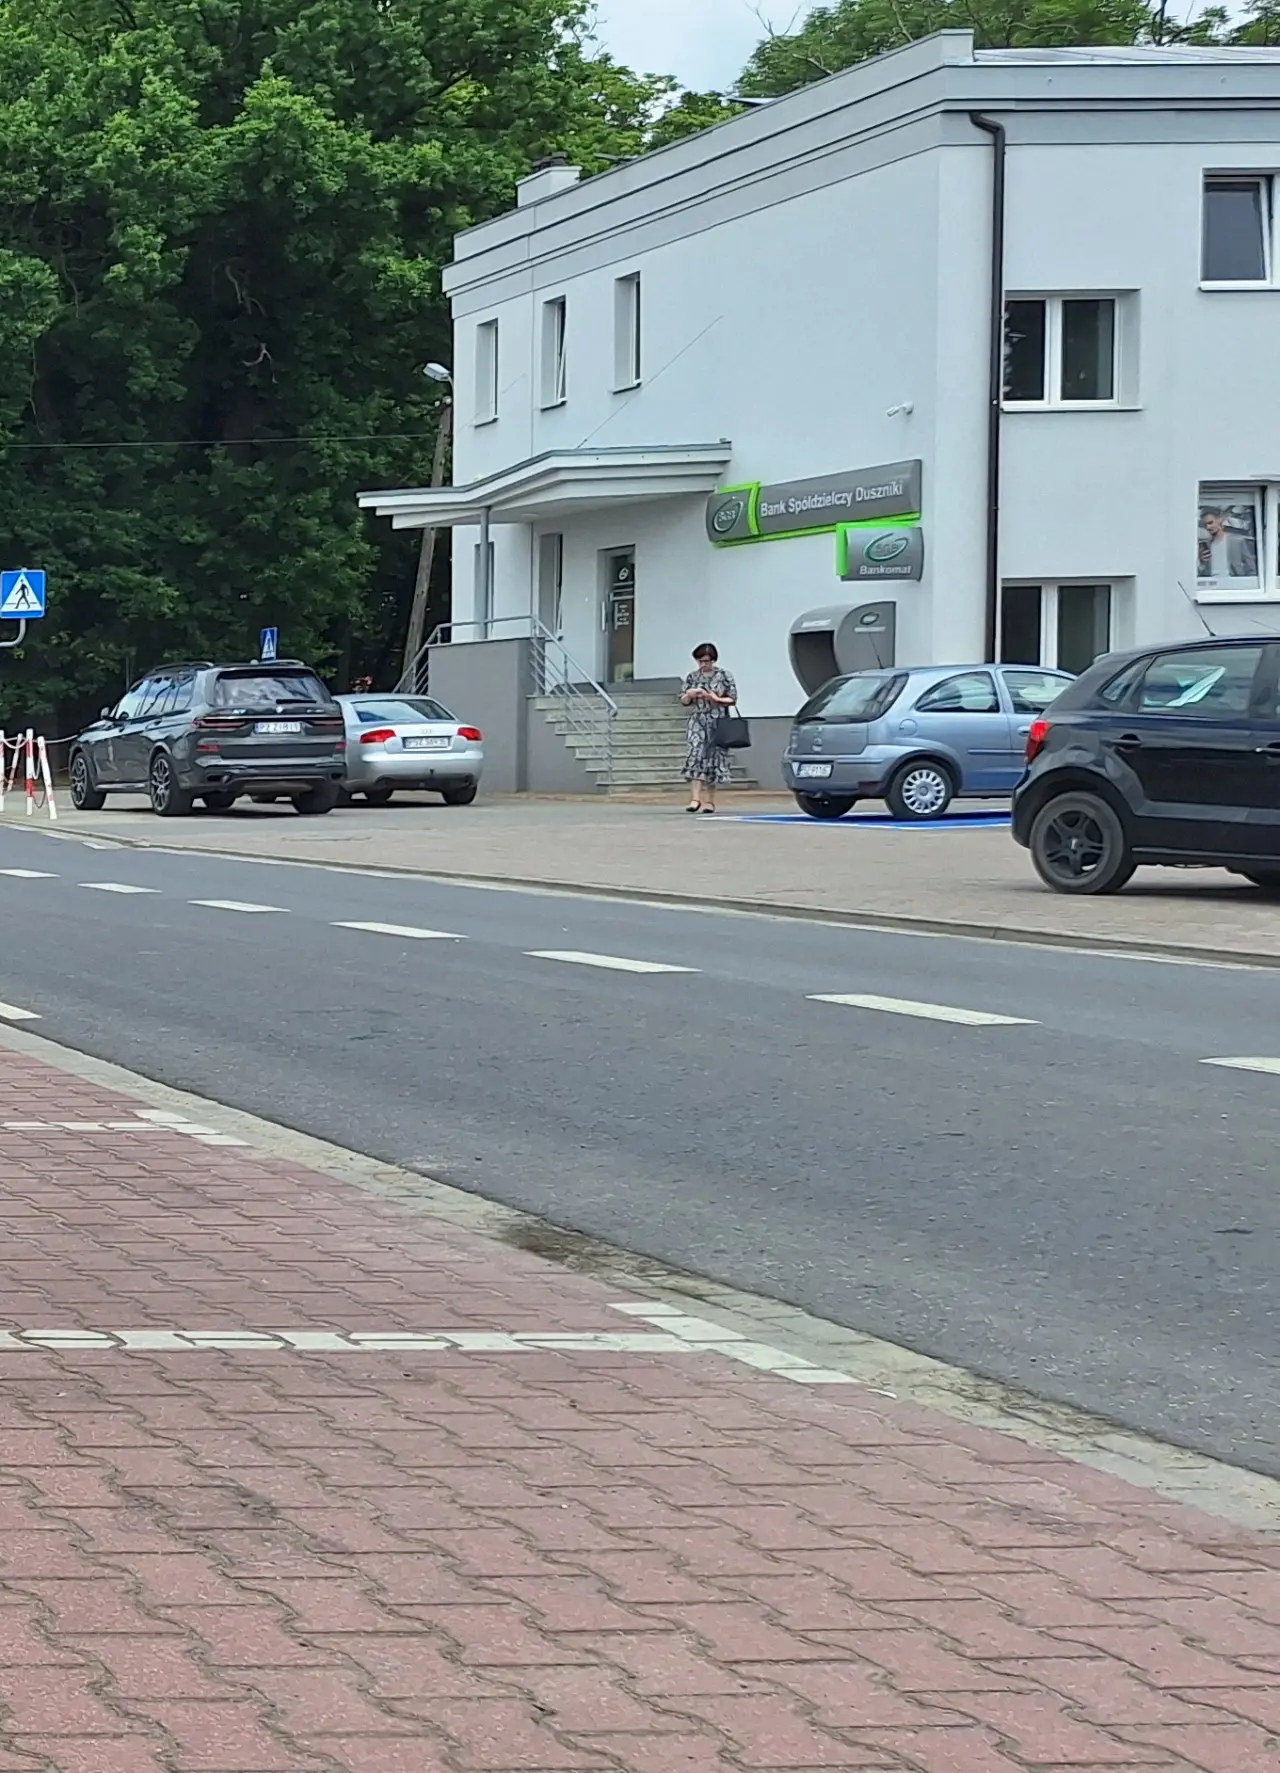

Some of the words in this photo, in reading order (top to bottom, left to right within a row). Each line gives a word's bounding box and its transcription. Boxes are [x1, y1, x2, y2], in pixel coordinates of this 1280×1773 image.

[760, 499, 787, 518] Bank
[789, 489, 854, 515] Spółdzielczy
[855, 480, 904, 502] Duszniki
[859, 564, 913, 576] Bankomat
